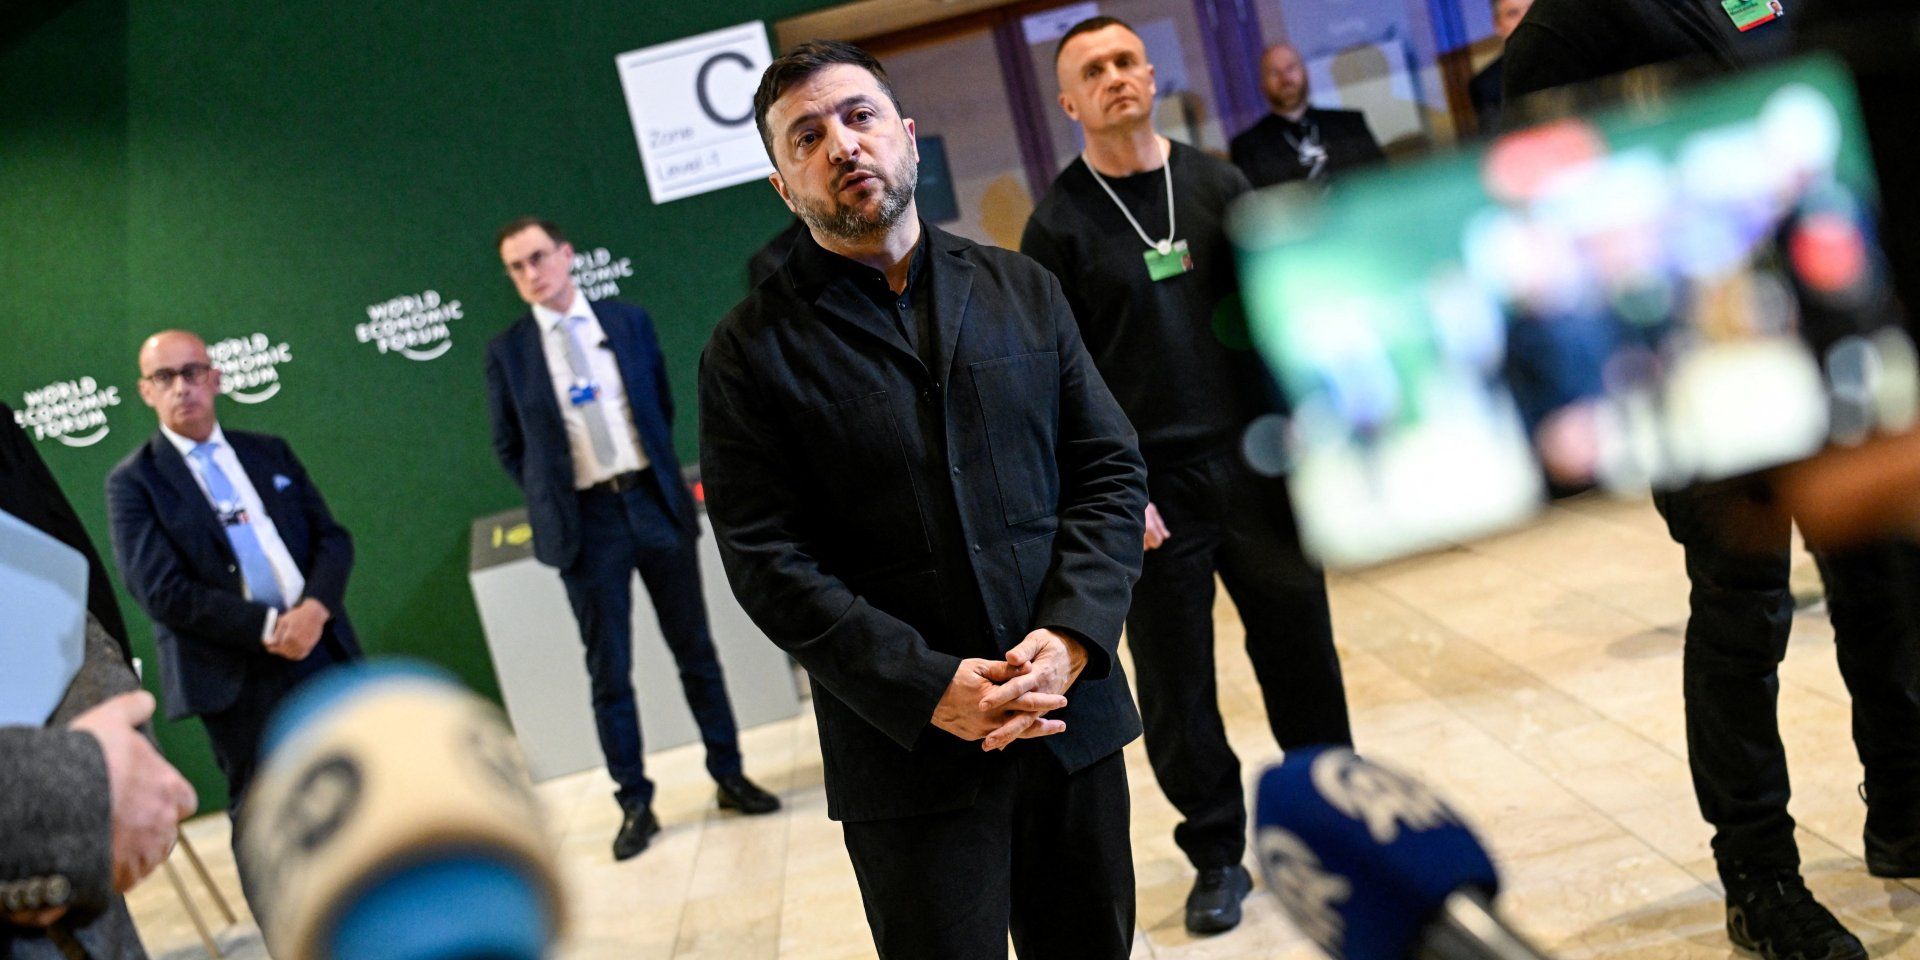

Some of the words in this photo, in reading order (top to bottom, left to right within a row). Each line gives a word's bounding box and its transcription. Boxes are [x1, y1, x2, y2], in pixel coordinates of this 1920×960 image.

[649, 126, 695, 149] Zone
[696, 51, 757, 128] C
[656, 154, 704, 180] Level
[567, 247, 611, 272] RLD
[366, 289, 440, 321] WORLD
[355, 300, 463, 343] ECONOMIC
[377, 323, 450, 354] FORUM
[23, 376, 97, 407] WORLD
[220, 366, 279, 394] ORUM
[13, 386, 121, 428] ECONOMIC
[34, 409, 107, 441] FORUM
